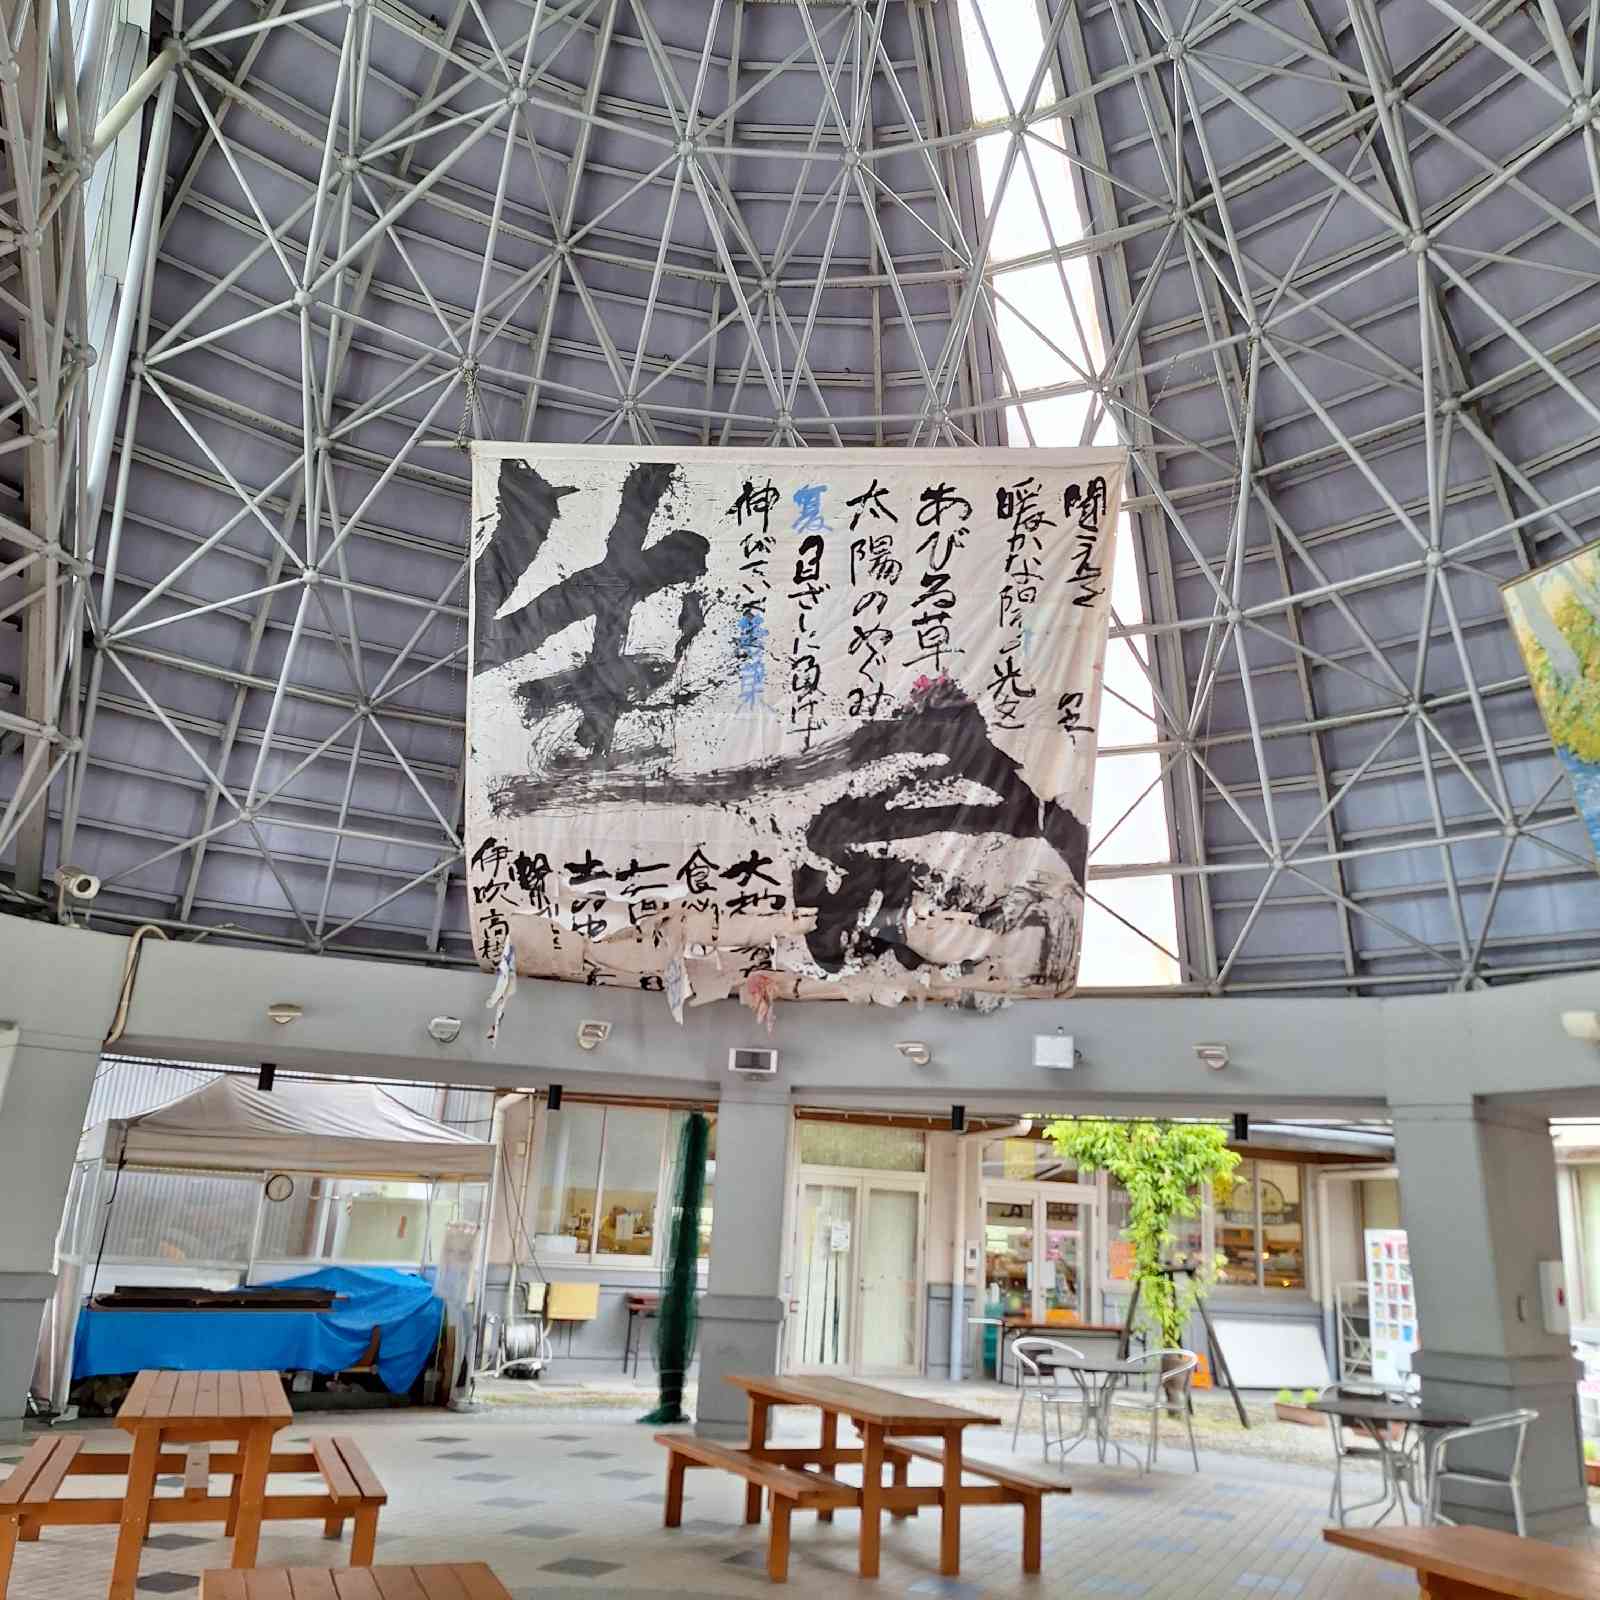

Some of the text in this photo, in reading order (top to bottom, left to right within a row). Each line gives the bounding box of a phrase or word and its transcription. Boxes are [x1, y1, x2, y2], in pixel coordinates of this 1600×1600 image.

[846, 478, 903, 717] 太陽のめぐみ
